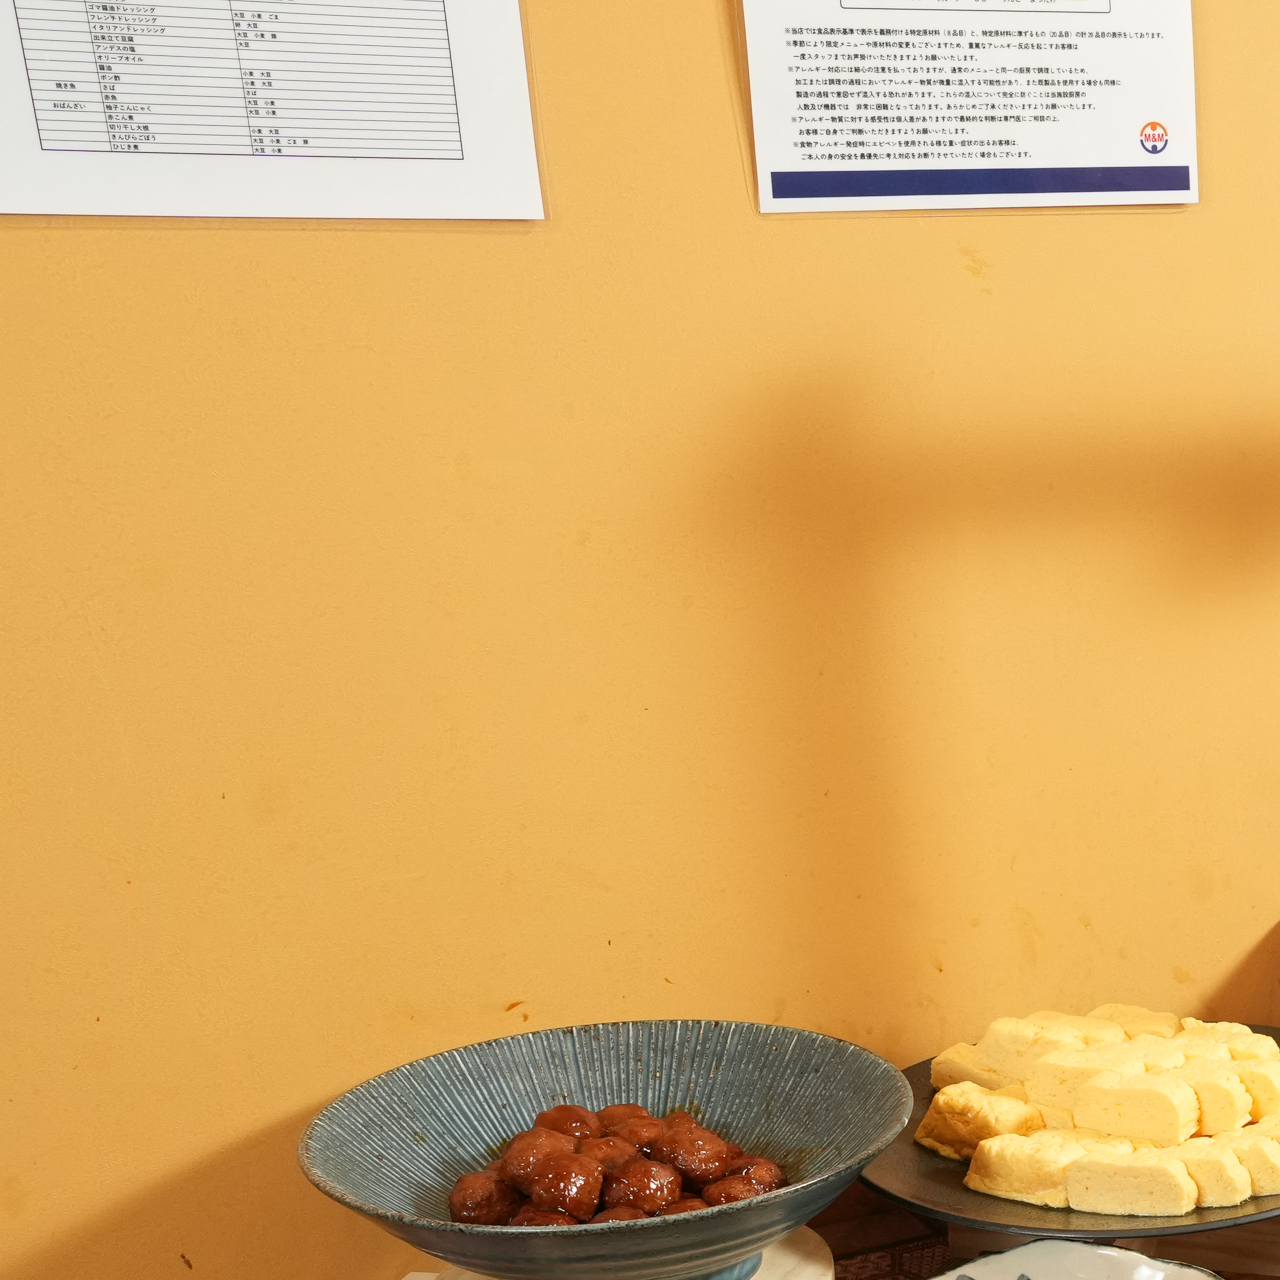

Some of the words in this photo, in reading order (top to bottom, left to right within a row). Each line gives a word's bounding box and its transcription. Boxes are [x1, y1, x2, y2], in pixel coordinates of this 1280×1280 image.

[90, 14, 157, 24] フレンチドレッシング
[92, 24, 166, 34] イタリアンドレッシング
[1144, 133, 1165, 143] M&M
